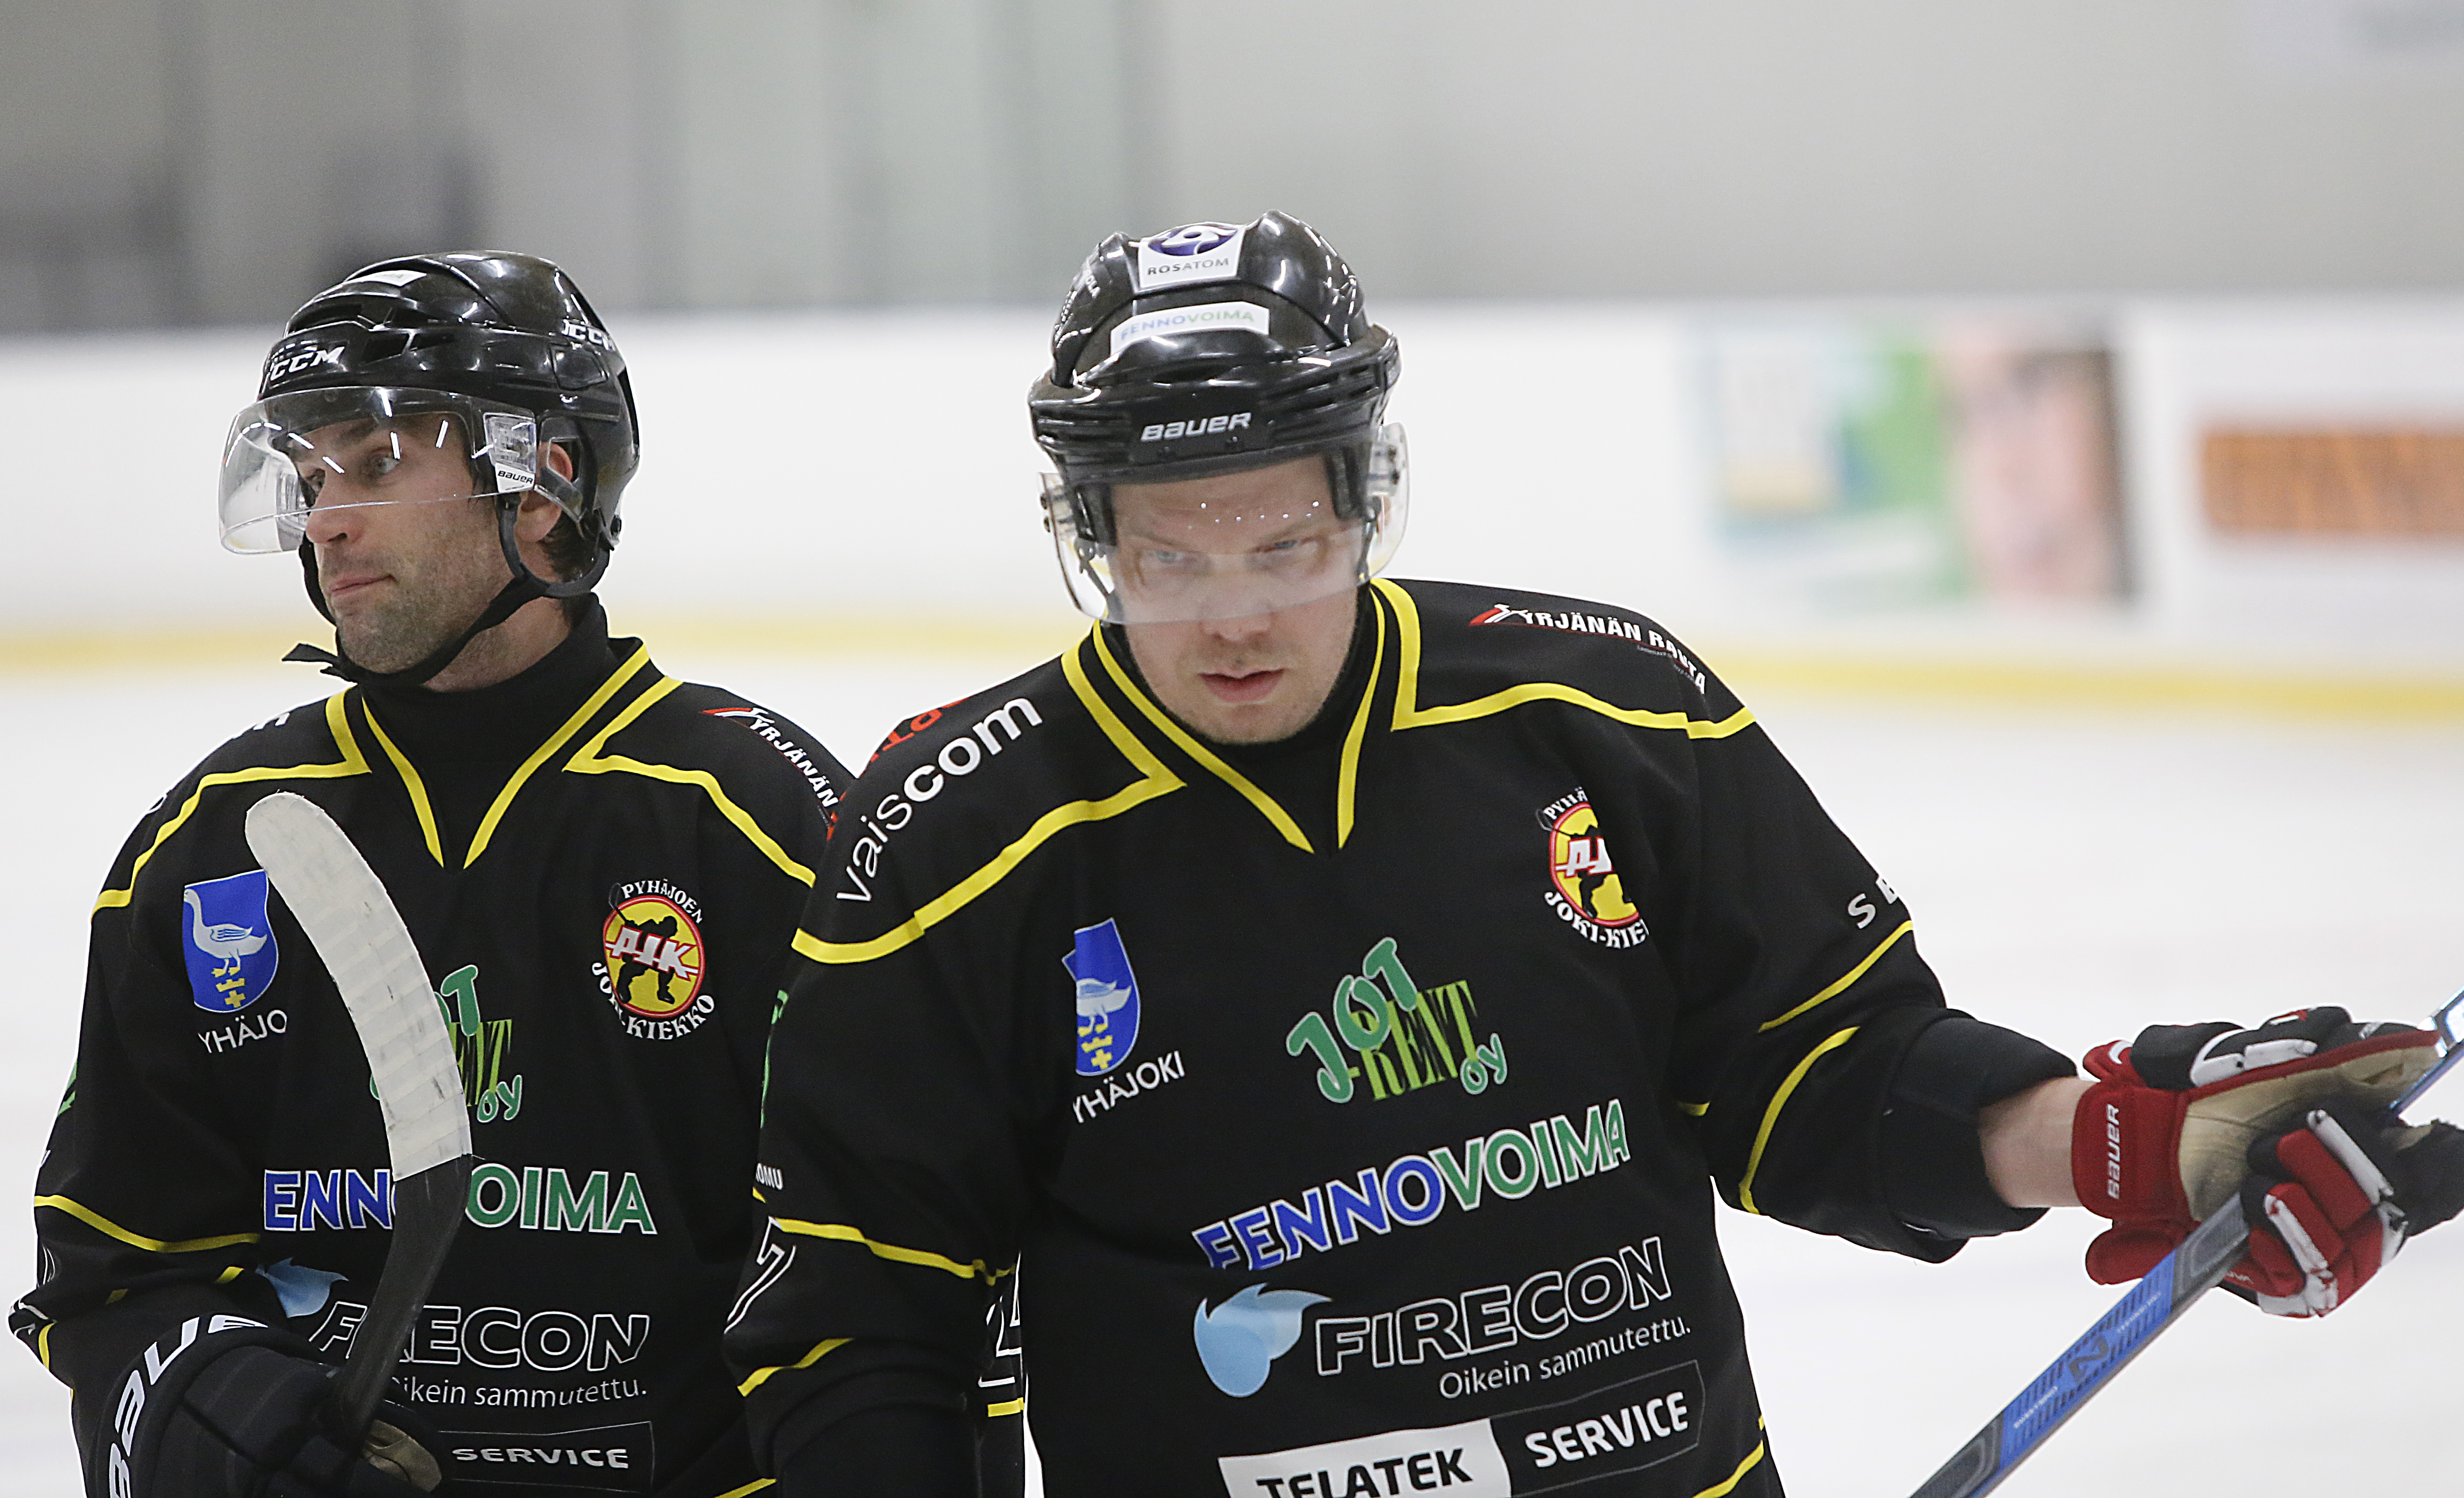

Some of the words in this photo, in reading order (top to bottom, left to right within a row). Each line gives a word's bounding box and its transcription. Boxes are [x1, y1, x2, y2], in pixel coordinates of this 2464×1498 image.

[1147, 257, 1229, 275] ROSATOM
[1120, 310, 1255, 341] FENNOVOIMA
[270, 346, 345, 381] CCM
[836, 697, 1043, 902] vaiscom
[1543, 786, 1589, 820] PYHÄ
[621, 878, 703, 924] PYHÄJOEN
[1544, 891, 1649, 950] JOKI-KIE
[198, 1009, 287, 1054] YHÄJO
[1286, 936, 1419, 1104] JOT
[1072, 1050, 1185, 1124] YHÄJOKI
[264, 1163, 658, 1235] ENNOIMA
[755, 1162, 784, 1190] OMU
[1191, 1098, 1631, 1271] FENNOVOIMA
[308, 1301, 650, 1372] FECON
[1315, 1236, 1672, 1377] FIRECON
[1439, 1360, 1530, 1399] Oikein
[1539, 1316, 1691, 1380] sammutettu.
[109, 1314, 268, 1498] BAUE
[391, 1376, 466, 1405] ikein
[474, 1378, 647, 1408] sammutettu.
[452, 1447, 629, 1469] SERVICE
[1524, 1391, 1688, 1468] SERVICE
